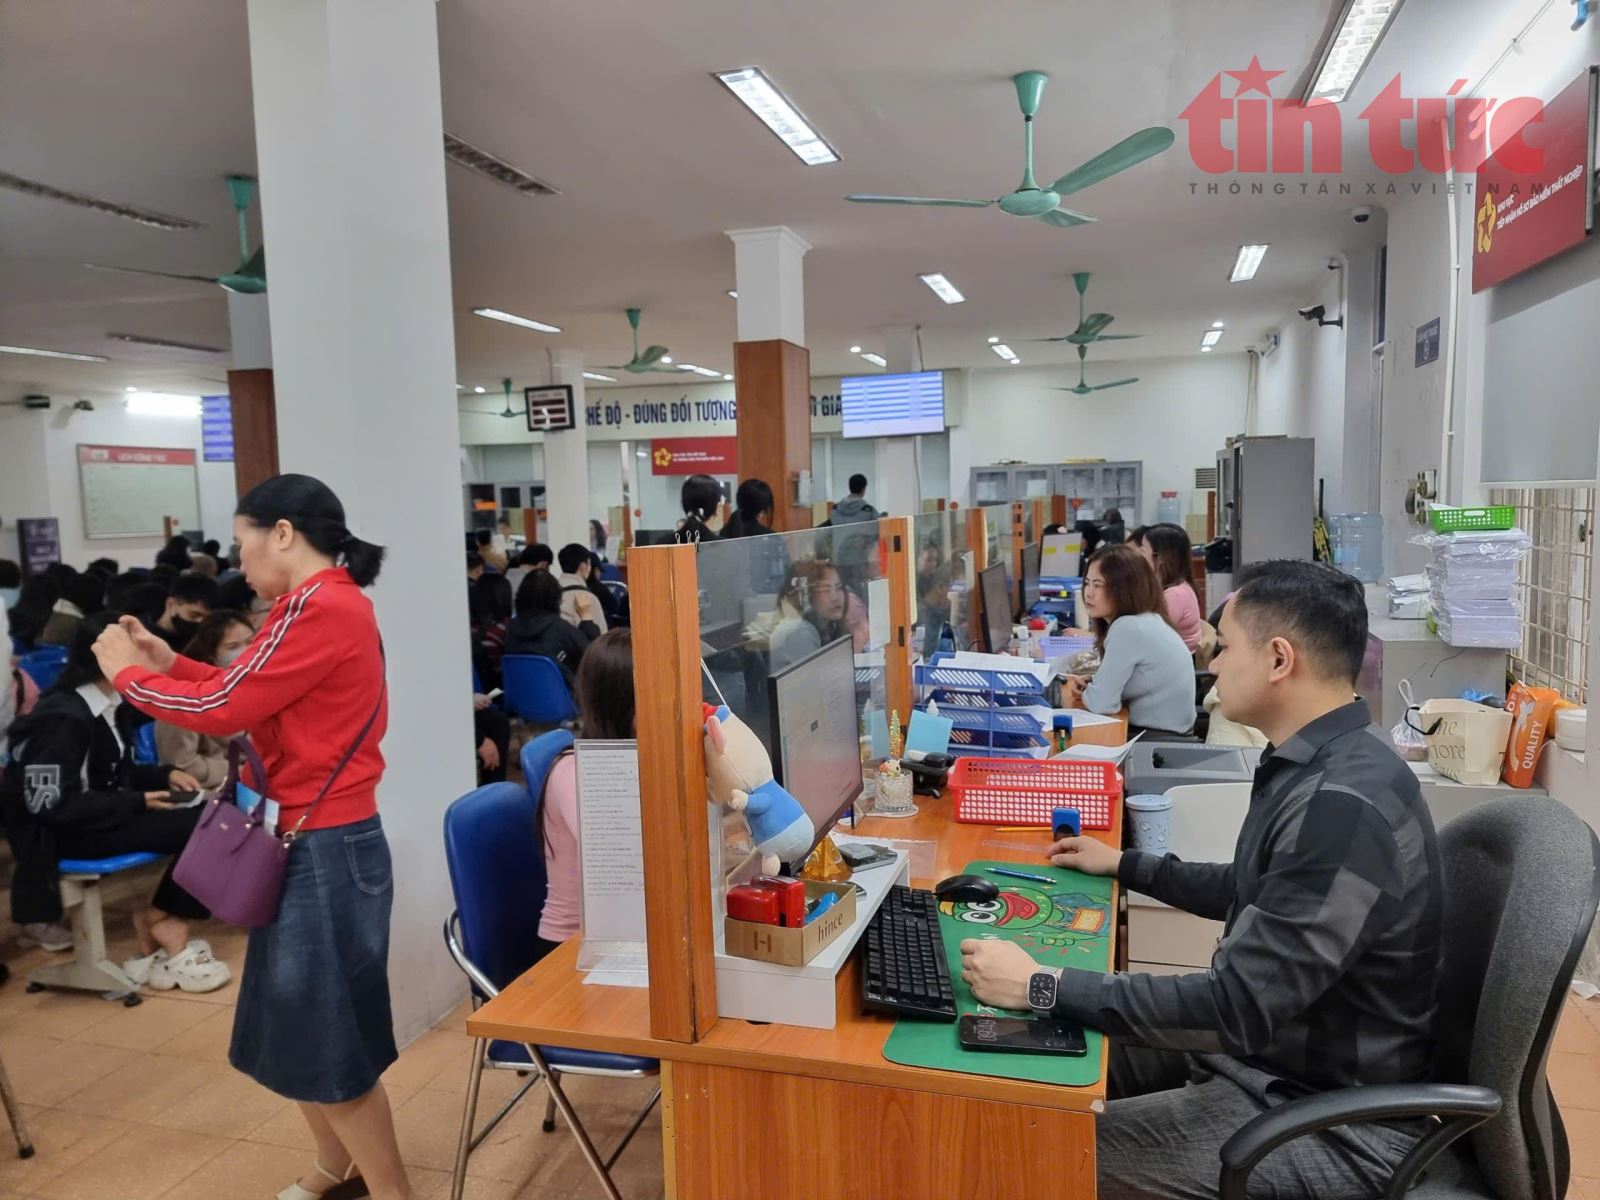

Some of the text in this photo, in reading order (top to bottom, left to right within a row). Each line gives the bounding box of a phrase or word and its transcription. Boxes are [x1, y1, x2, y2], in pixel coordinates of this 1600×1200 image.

[586, 398, 602, 425] HẾ
[605, 400, 621, 430] ĐỘ
[633, 399, 667, 424] ĐÚNG
[670, 395, 691, 422] ĐỐI
[694, 399, 736, 426] TƯỢNG
[1522, 720, 1543, 769] QUALITY
[818, 913, 843, 943] hince
